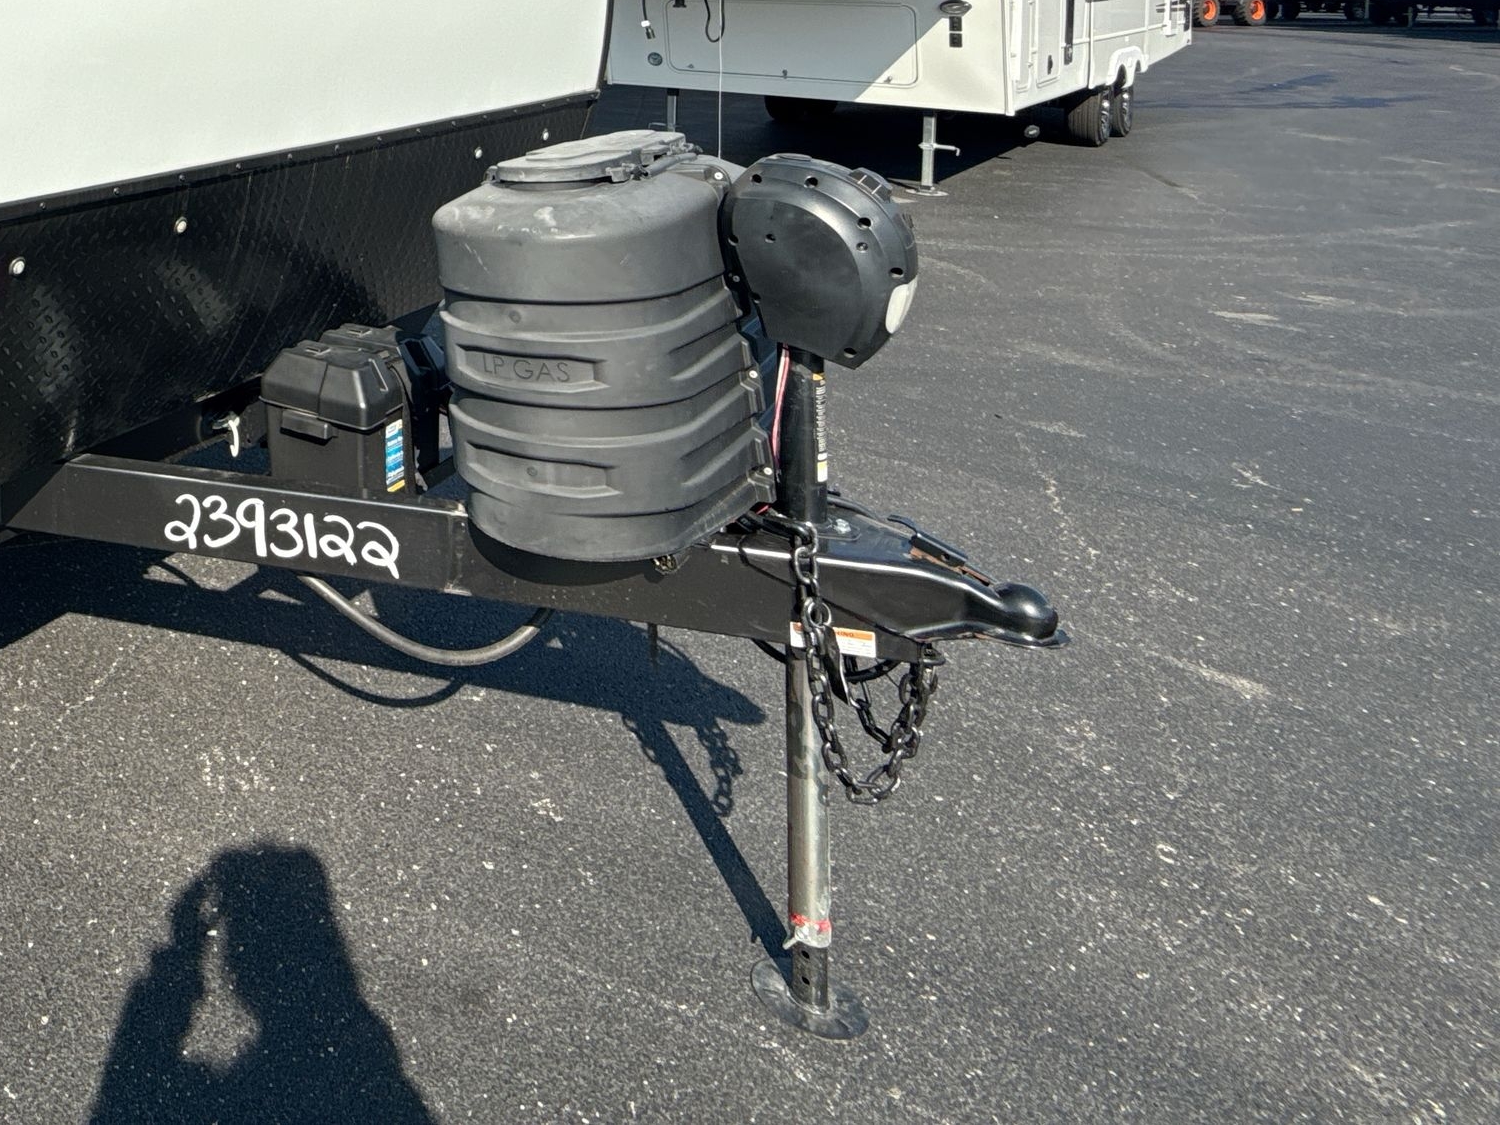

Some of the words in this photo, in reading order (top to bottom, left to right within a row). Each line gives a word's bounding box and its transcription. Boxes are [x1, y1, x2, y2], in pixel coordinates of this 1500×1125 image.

[483, 354, 505, 375] LP
[513, 359, 570, 383] GAS
[164, 493, 400, 580] 2393122
